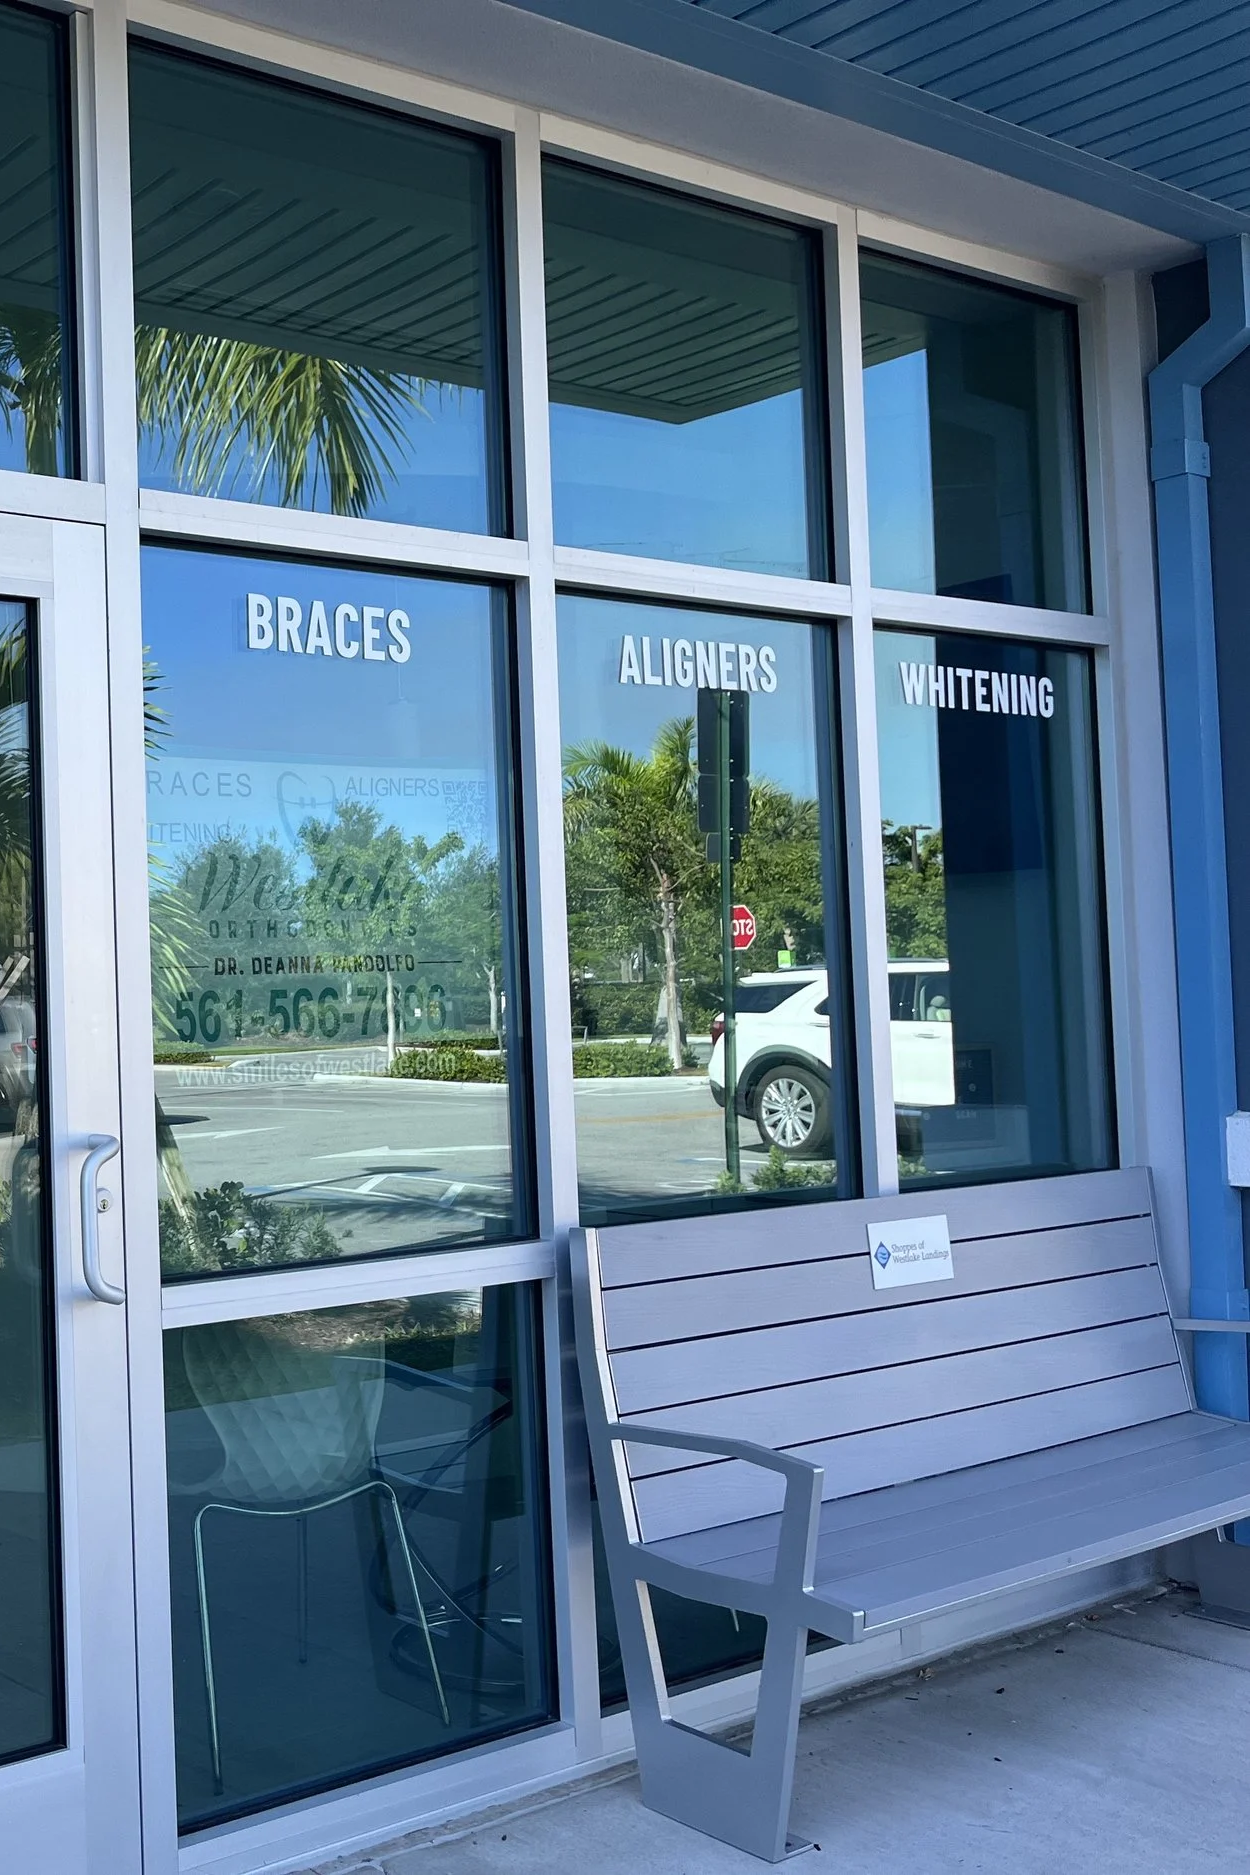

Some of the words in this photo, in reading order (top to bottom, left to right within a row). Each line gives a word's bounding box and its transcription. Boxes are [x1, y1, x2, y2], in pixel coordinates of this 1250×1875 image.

[247, 593, 411, 664] BRACES
[619, 635, 778, 693] ALIGNERS
[899, 662, 1054, 718] WHITENING
[345, 776, 440, 797] ALIGNERS
[214, 957, 244, 976] DR.
[252, 955, 324, 976] DEANNA
[891, 1243, 917, 1255] Shoppes
[918, 1240, 925, 1250] of
[892, 1252, 921, 1264] Westlake
[921, 1250, 949, 1261] Landings
